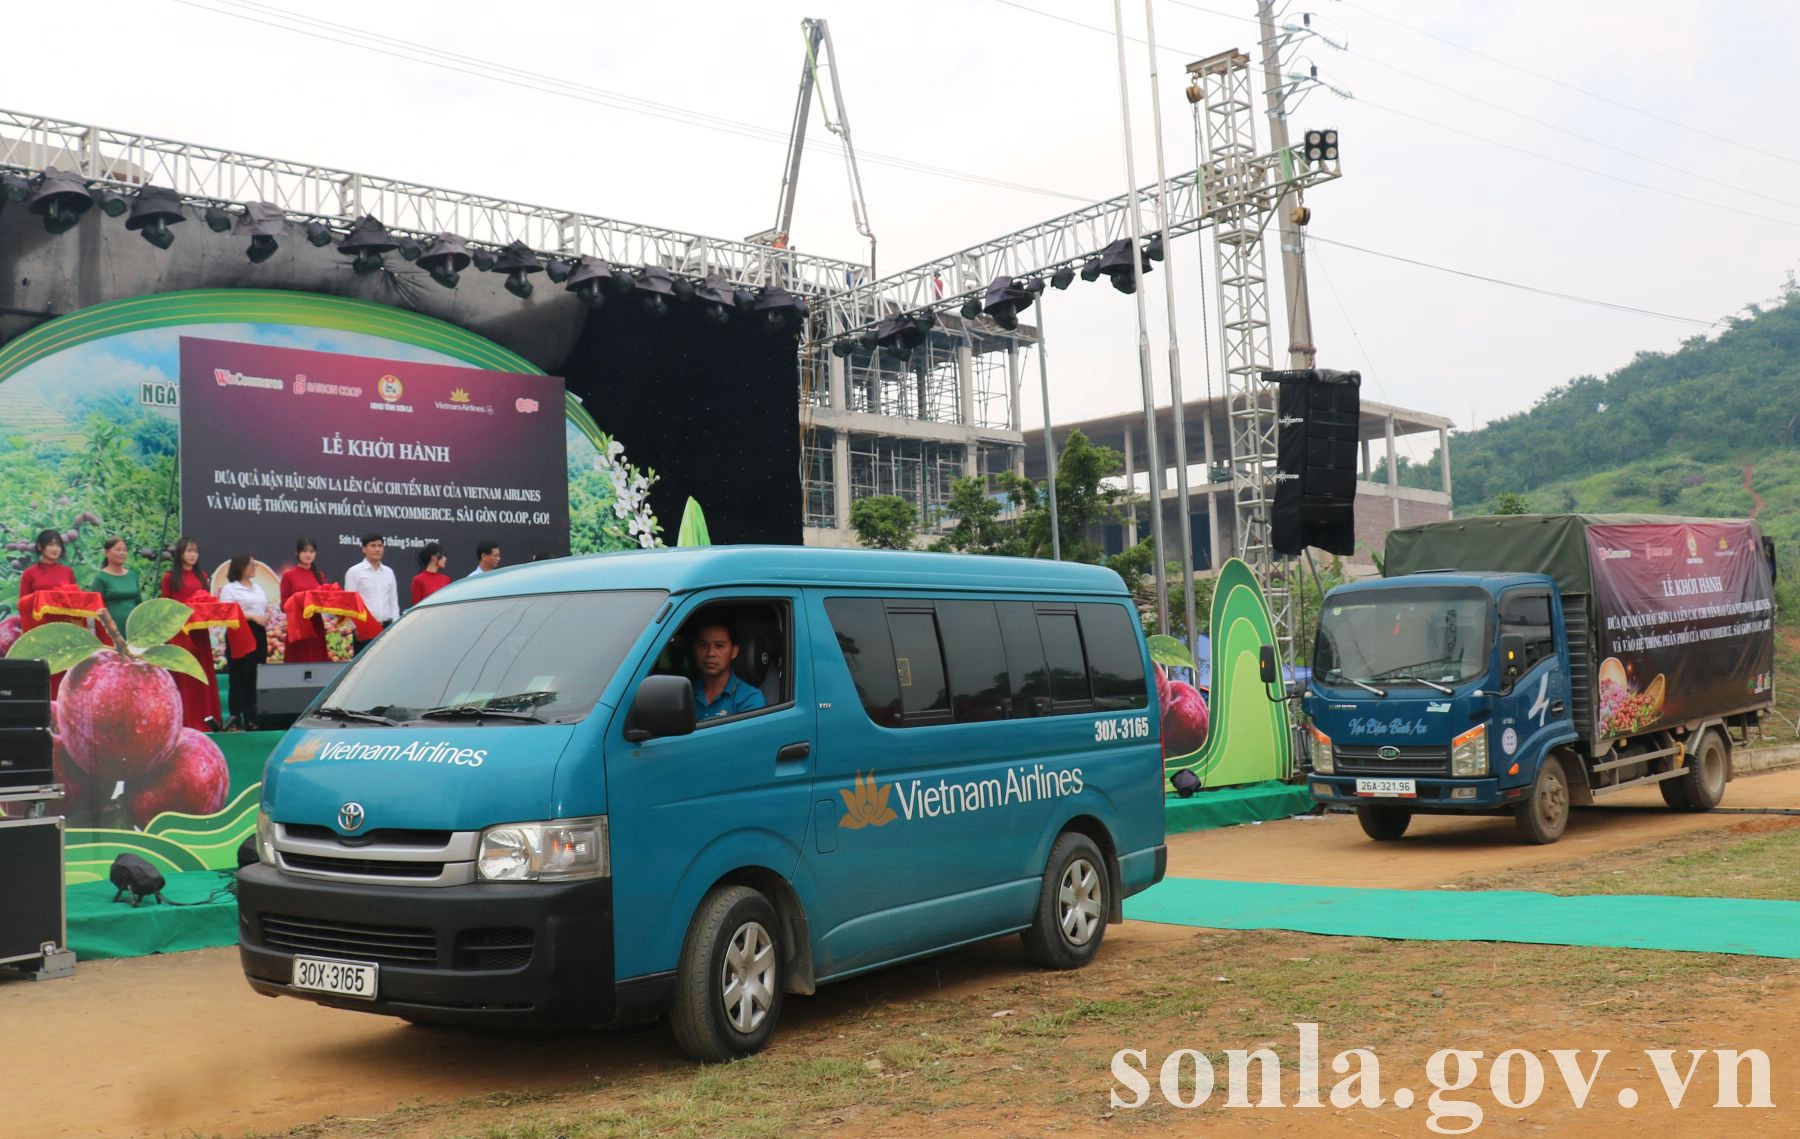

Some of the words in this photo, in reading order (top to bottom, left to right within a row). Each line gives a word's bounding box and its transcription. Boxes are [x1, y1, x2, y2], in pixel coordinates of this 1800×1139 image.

[142, 380, 178, 405] NGÀ
[321, 431, 343, 455] LỄ
[347, 437, 395, 459] KHỞI
[399, 441, 450, 463] HÀNH
[214, 469, 236, 485] ĐƯA
[238, 468, 259, 488] QUẢ
[261, 470, 284, 490] MẬN
[285, 472, 306, 491] HẬU
[307, 475, 328, 491] SƠN
[328, 478, 342, 491] LA
[343, 476, 364, 493] LÊN
[363, 477, 384, 494] CÁC
[384, 478, 423, 497] CHUYẾN
[423, 484, 442, 498] BAY
[443, 481, 462, 499] CỦA
[462, 486, 502, 500] VIETNAM
[502, 488, 541, 502] AIRLINES
[207, 492, 223, 510] VÀ
[223, 493, 247, 511] VÀO
[247, 494, 263, 514] HỆ
[264, 493, 299, 514] THỐNG
[299, 497, 330, 515] PHÂN
[328, 497, 351, 517] PHỐI
[352, 500, 373, 518] CỦA
[373, 505, 455, 523] WINCOMMERCE,
[456, 505, 474, 522] SÀI
[475, 506, 498, 523] GÒN
[532, 512, 551, 526] GO!
[405, 538, 410, 547] 5
[410, 537, 425, 548] năm
[1094, 716, 1149, 742] 30X-3165
